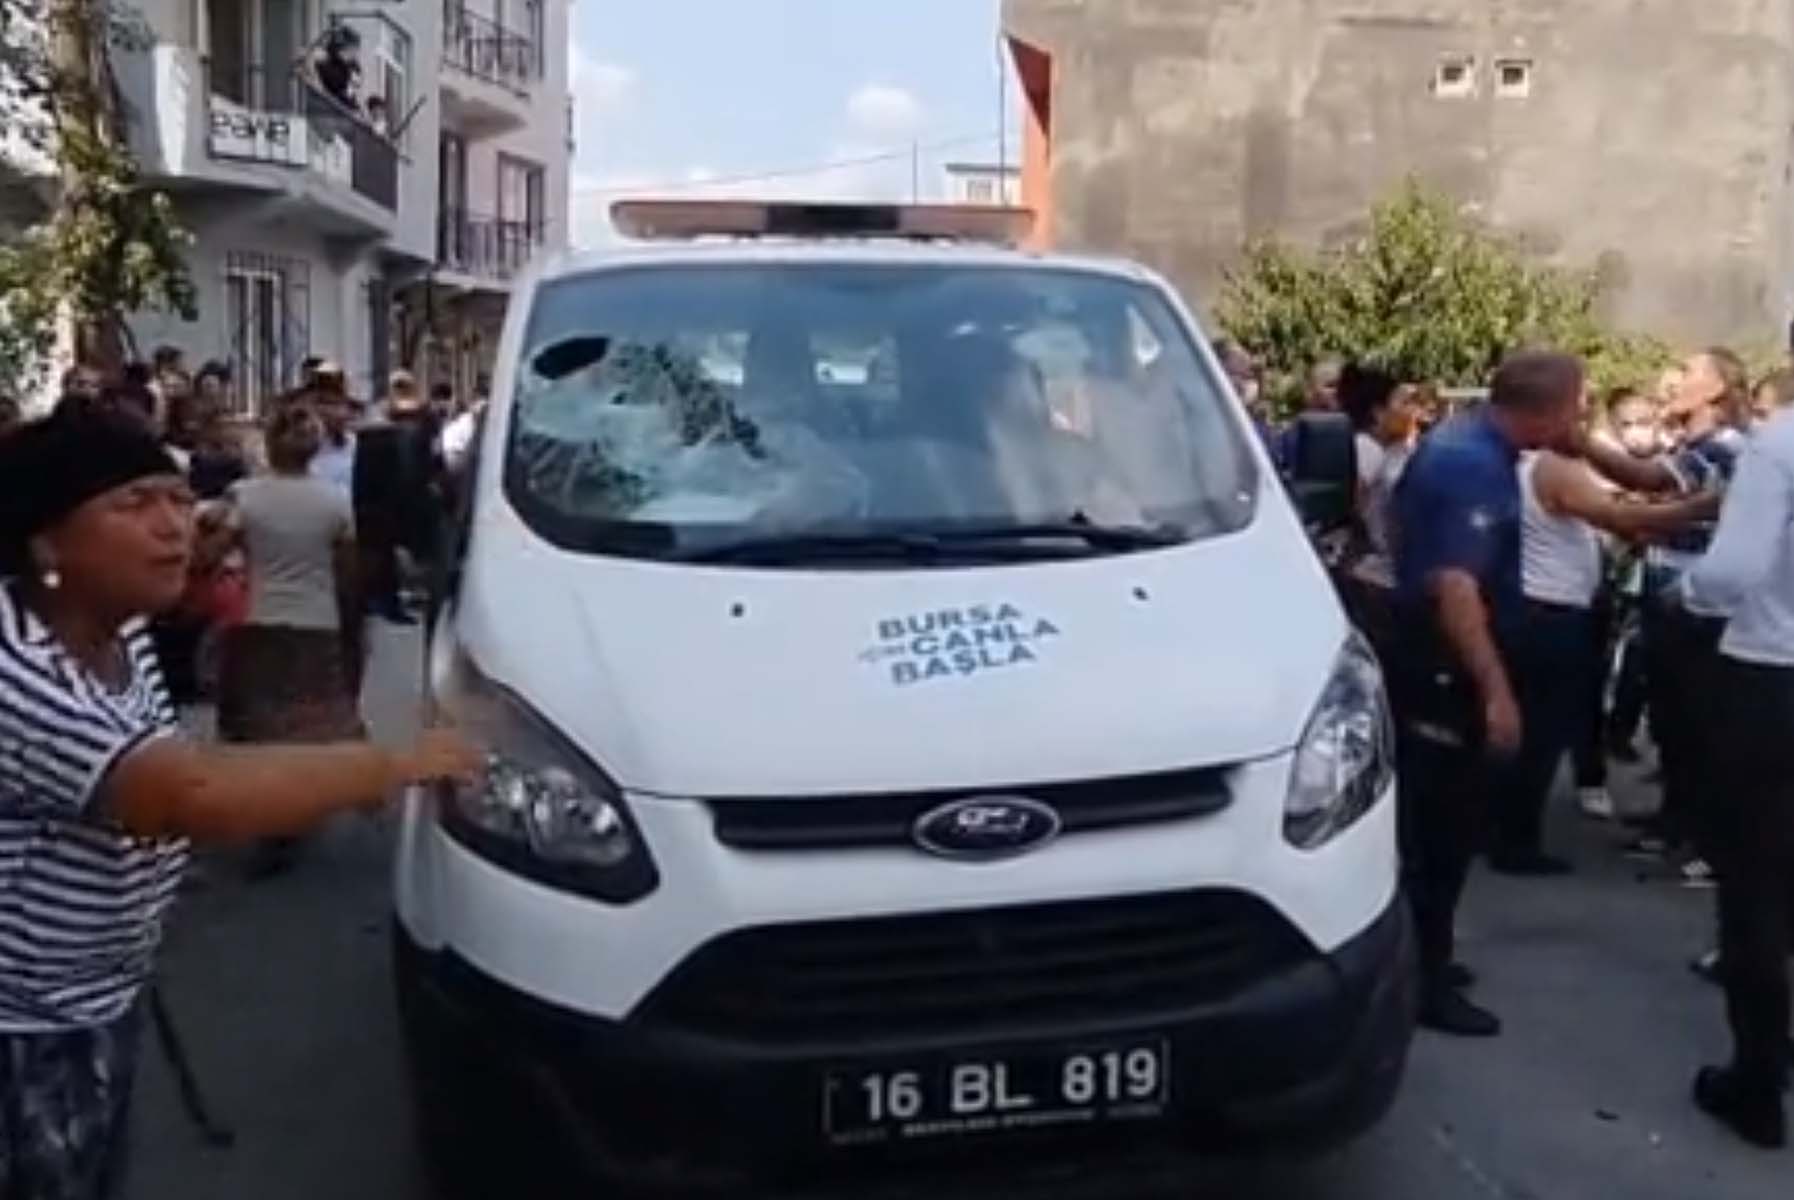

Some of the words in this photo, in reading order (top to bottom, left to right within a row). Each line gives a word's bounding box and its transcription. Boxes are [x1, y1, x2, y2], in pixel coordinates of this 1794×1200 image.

[878, 602, 1021, 640] BURSA
[911, 618, 1060, 656] CANLA
[862, 1071, 922, 1121] 16
[949, 1061, 1034, 1114] BL
[1060, 1047, 1158, 1104] 819
